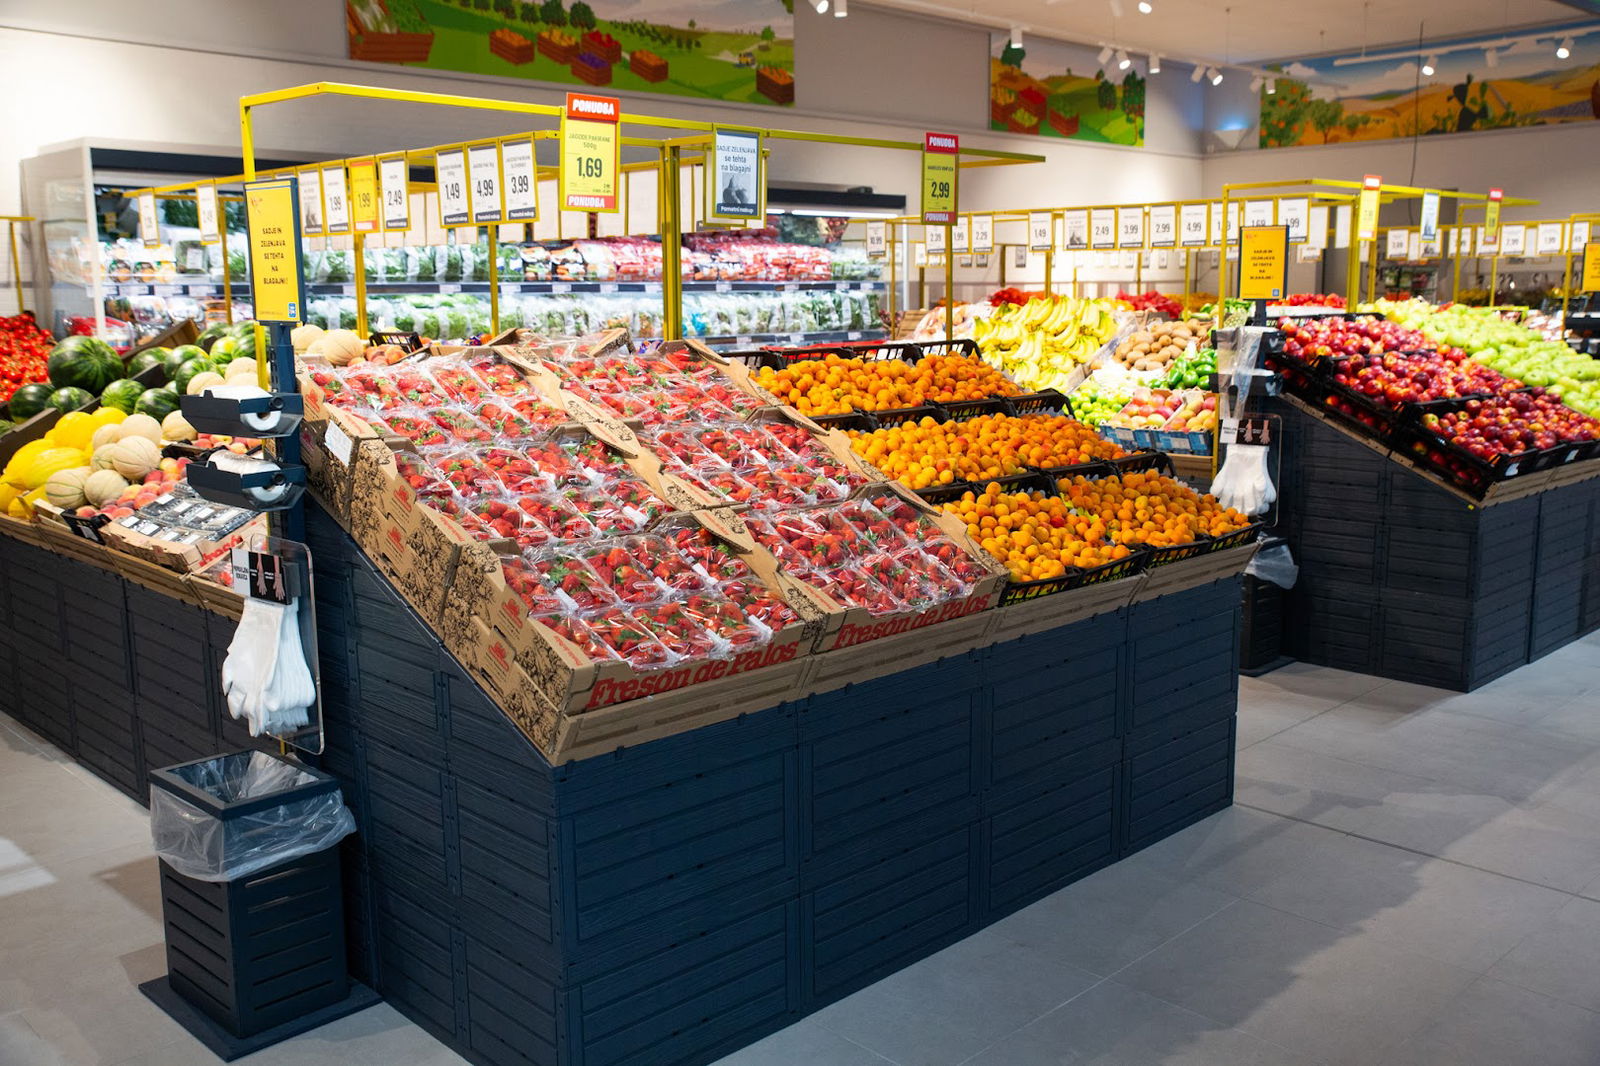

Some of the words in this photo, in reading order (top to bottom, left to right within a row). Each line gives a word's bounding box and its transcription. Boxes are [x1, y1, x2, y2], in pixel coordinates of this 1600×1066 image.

[572, 98, 614, 116] PONUDBA
[576, 157, 602, 179] 1,69
[732, 155, 746, 164] tehta
[730, 164, 751, 174] blagajni
[445, 182, 460, 200] 1,49
[477, 179, 494, 198] 4,99
[511, 175, 529, 194] 3,99
[931, 182, 950, 199] 2,99
[568, 196, 605, 208] PONUDBA
[831, 614, 910, 650] Fresón
[910, 608, 935, 633] de
[935, 592, 993, 623] Palos
[585, 666, 692, 709] Fresón
[692, 659, 729, 685] de
[728, 641, 800, 675] Palos
